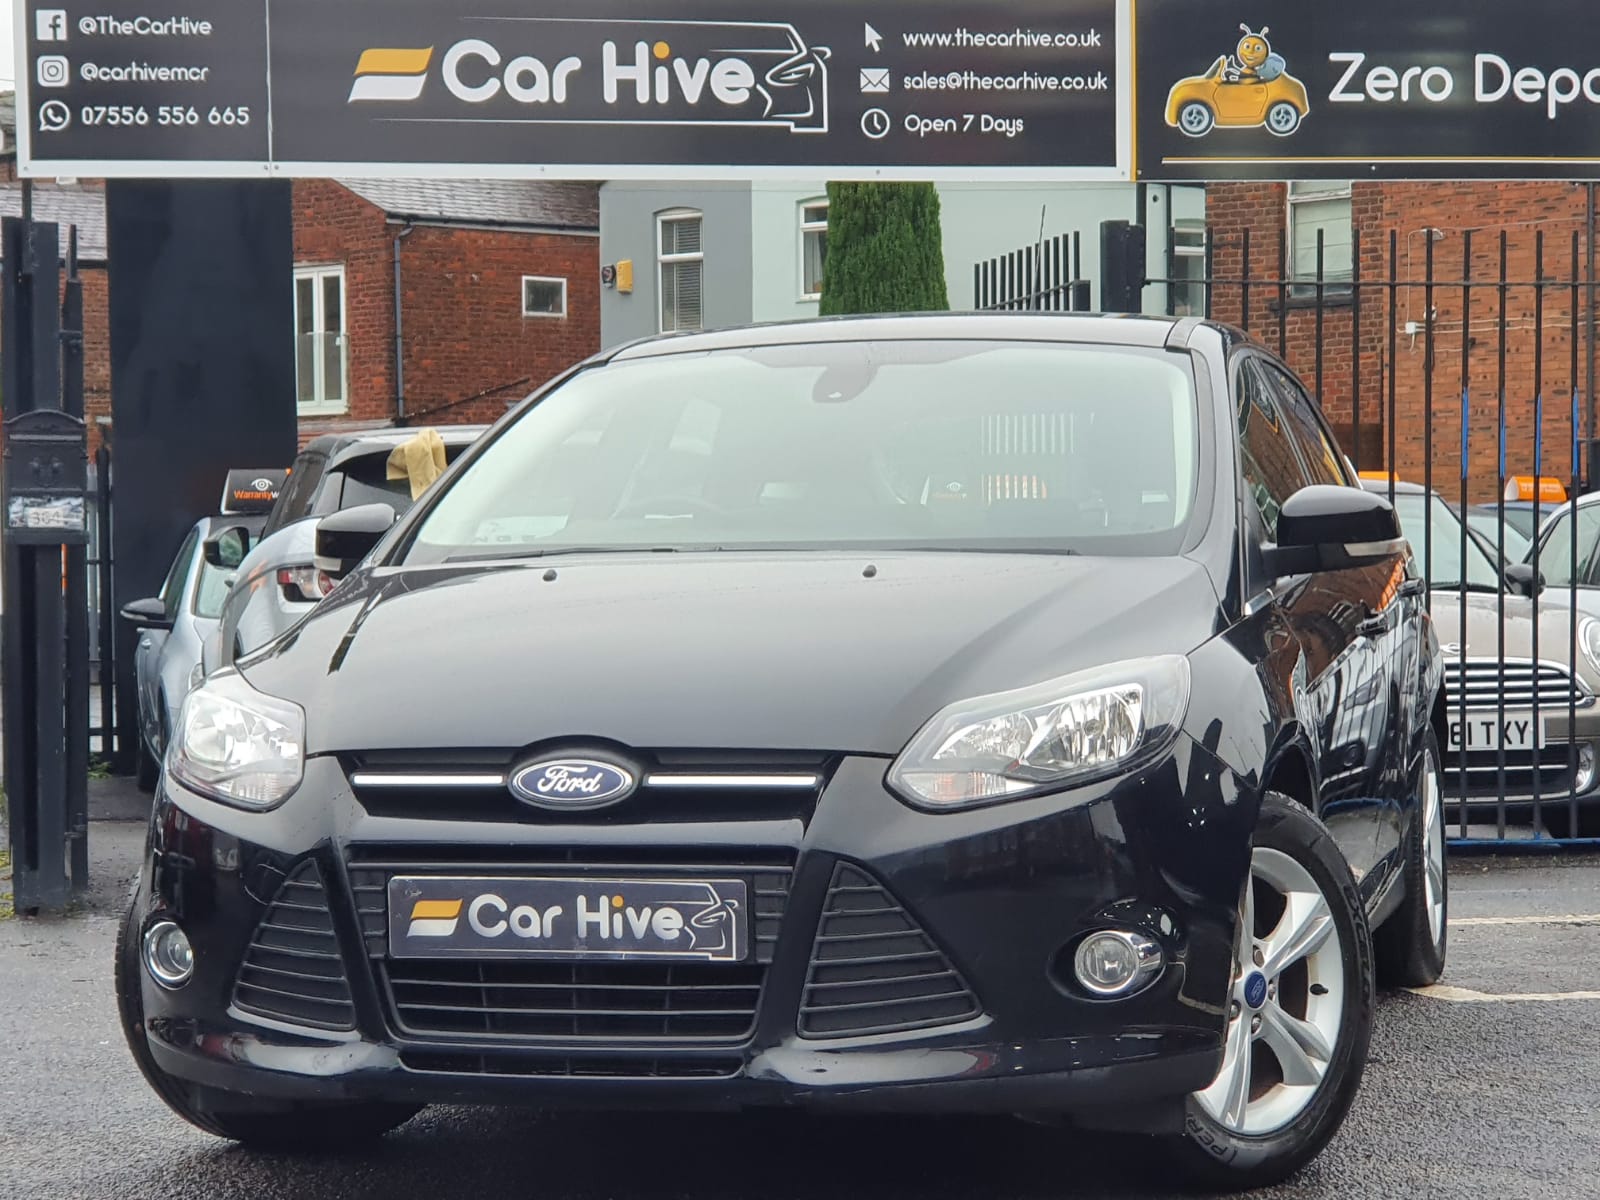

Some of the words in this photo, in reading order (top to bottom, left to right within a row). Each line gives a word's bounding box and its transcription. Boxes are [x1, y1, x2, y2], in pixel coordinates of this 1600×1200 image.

[78, 16, 213, 36] @TheCarHive
[902, 28, 1102, 47] www.thecarhive.co.uk
[80, 62, 209, 81] @carhivemcr
[441, 38, 583, 104] Car
[602, 40, 756, 105] Hive
[903, 71, 1108, 90] sales@thecarhive.co.uk
[1328, 52, 1454, 103] Zero
[81, 106, 149, 126] 07556
[157, 106, 200, 126] 556
[207, 106, 250, 126] 665
[904, 115, 957, 137] Open
[962, 115, 975, 132] 7
[980, 115, 1024, 138] Days
[537, 765, 603, 793] Ford
[468, 893, 563, 938] Car
[577, 894, 684, 940] Hive
